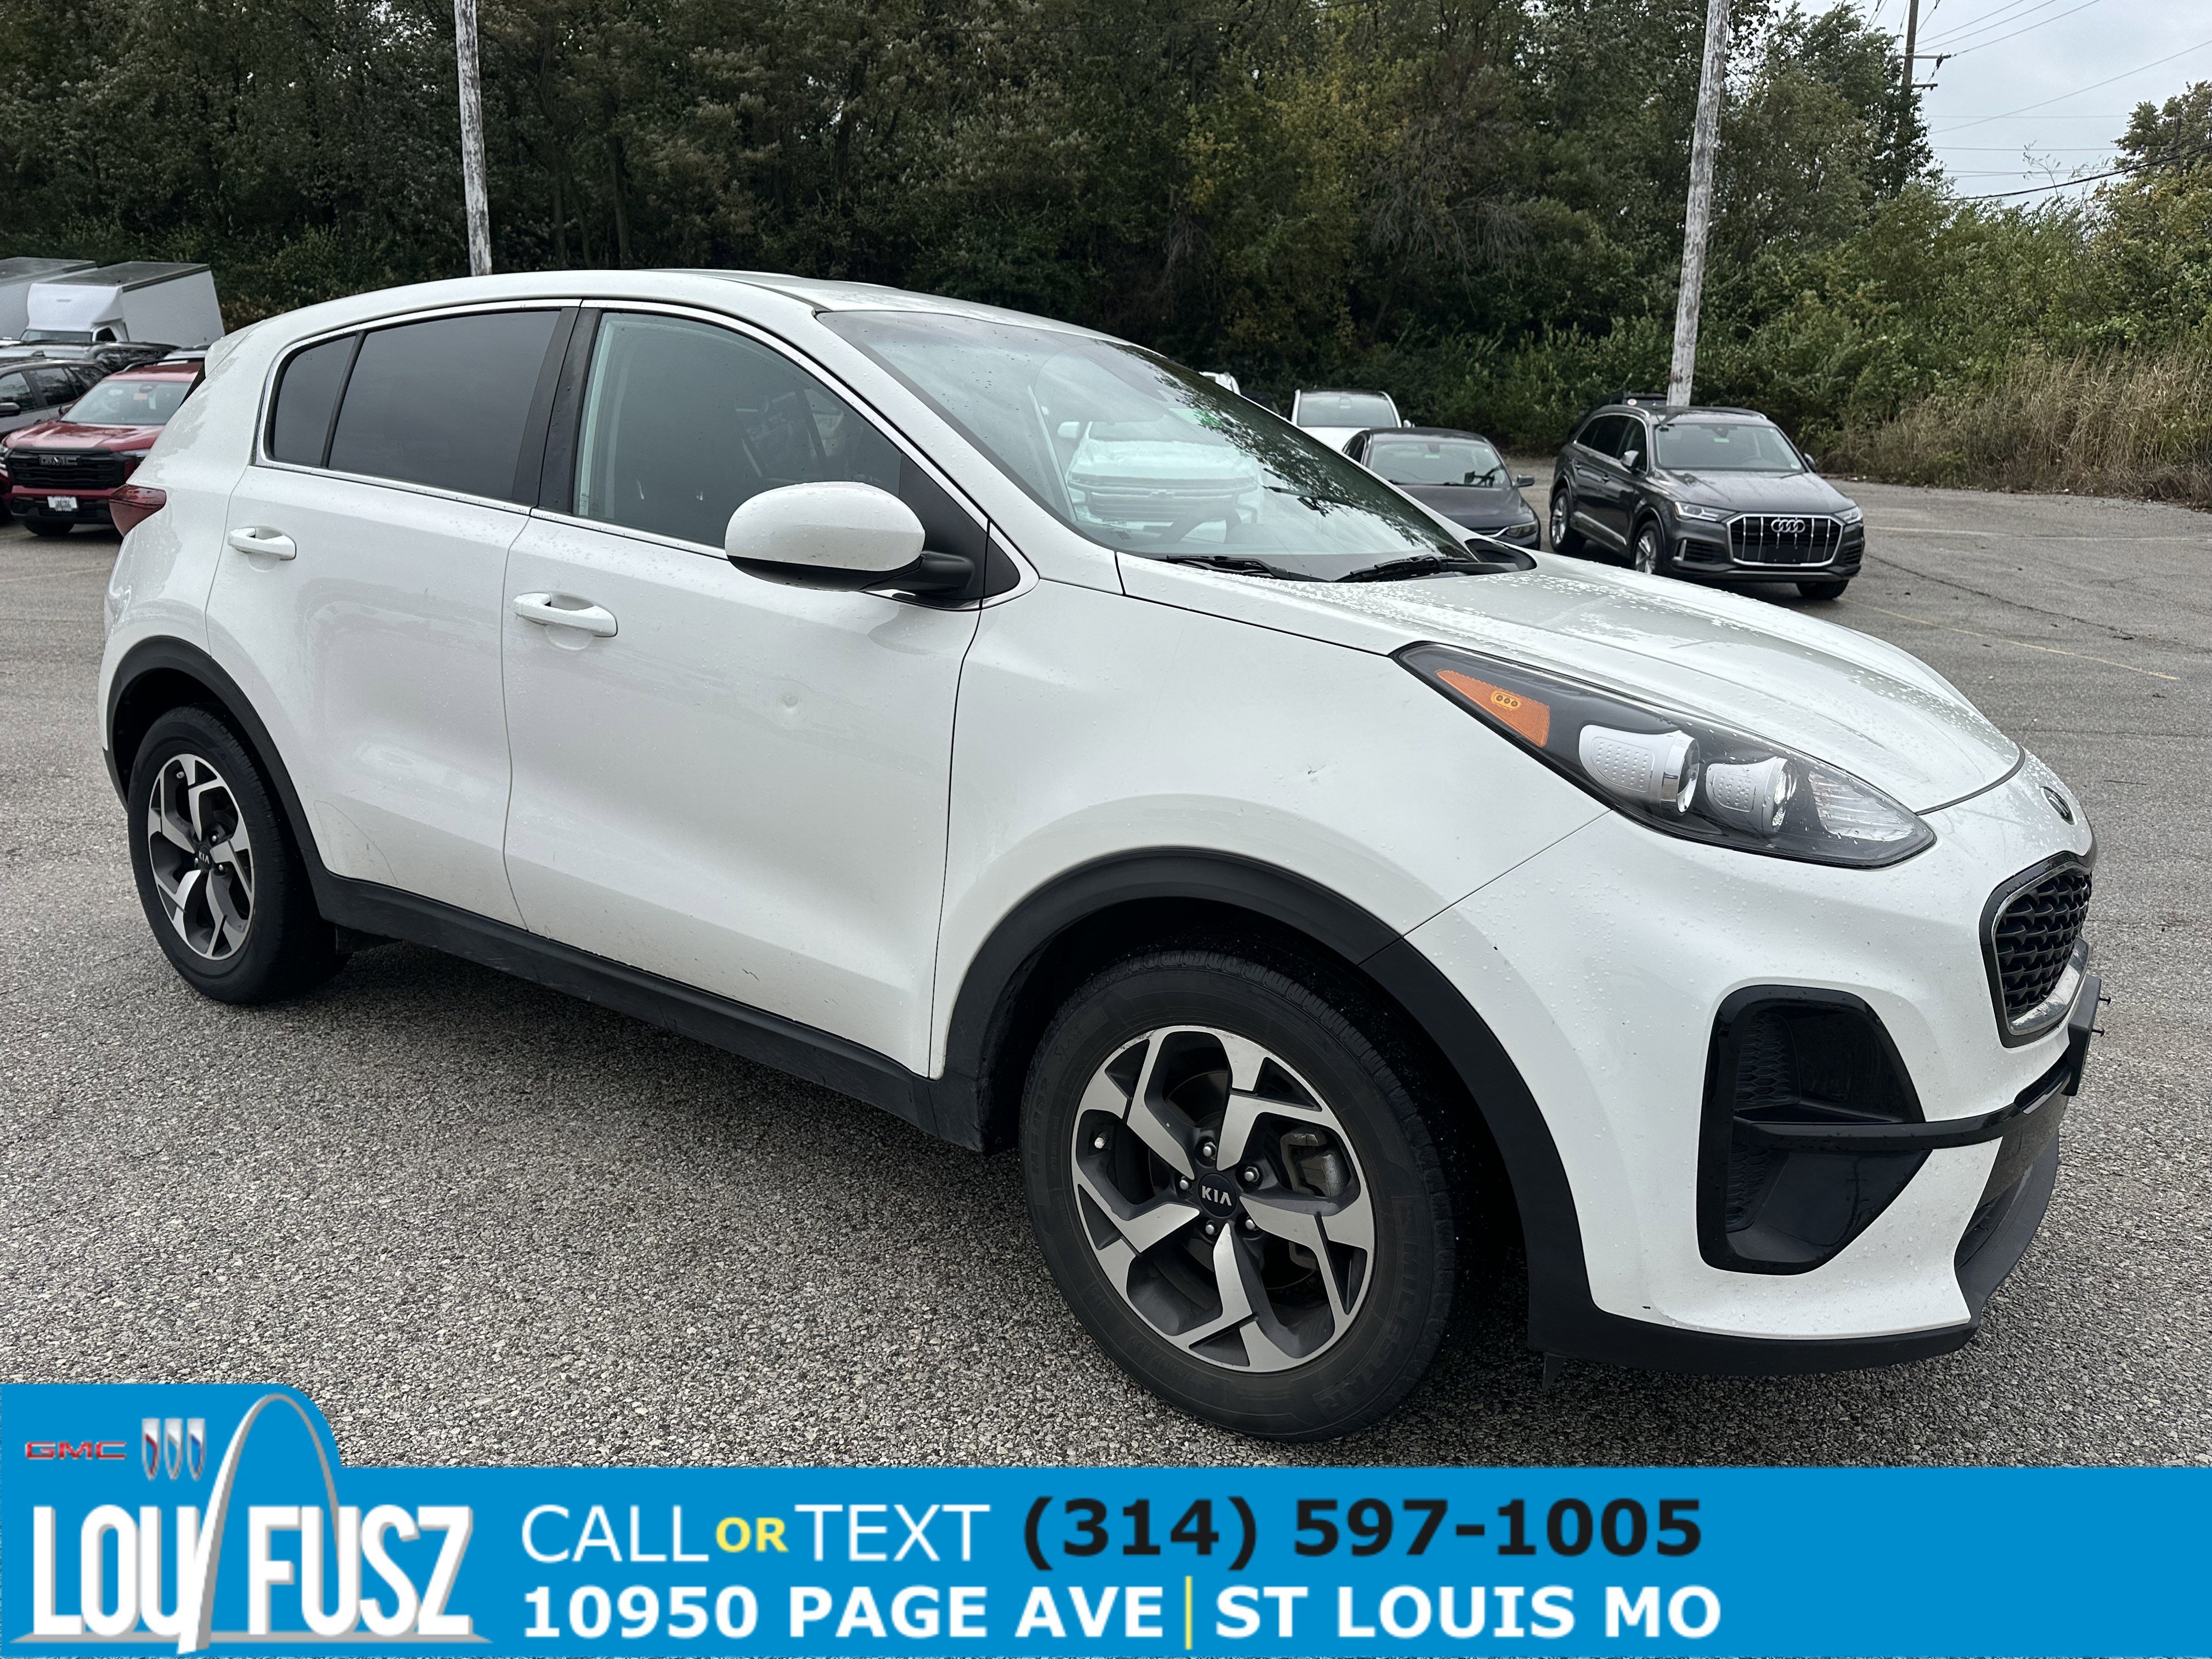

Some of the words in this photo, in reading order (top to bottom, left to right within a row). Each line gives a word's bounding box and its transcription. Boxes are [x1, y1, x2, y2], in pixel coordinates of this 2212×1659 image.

[39, 456, 77, 466] GMC
[199, 850, 210, 865] KIA
[1201, 1185, 1232, 1206] KIA
